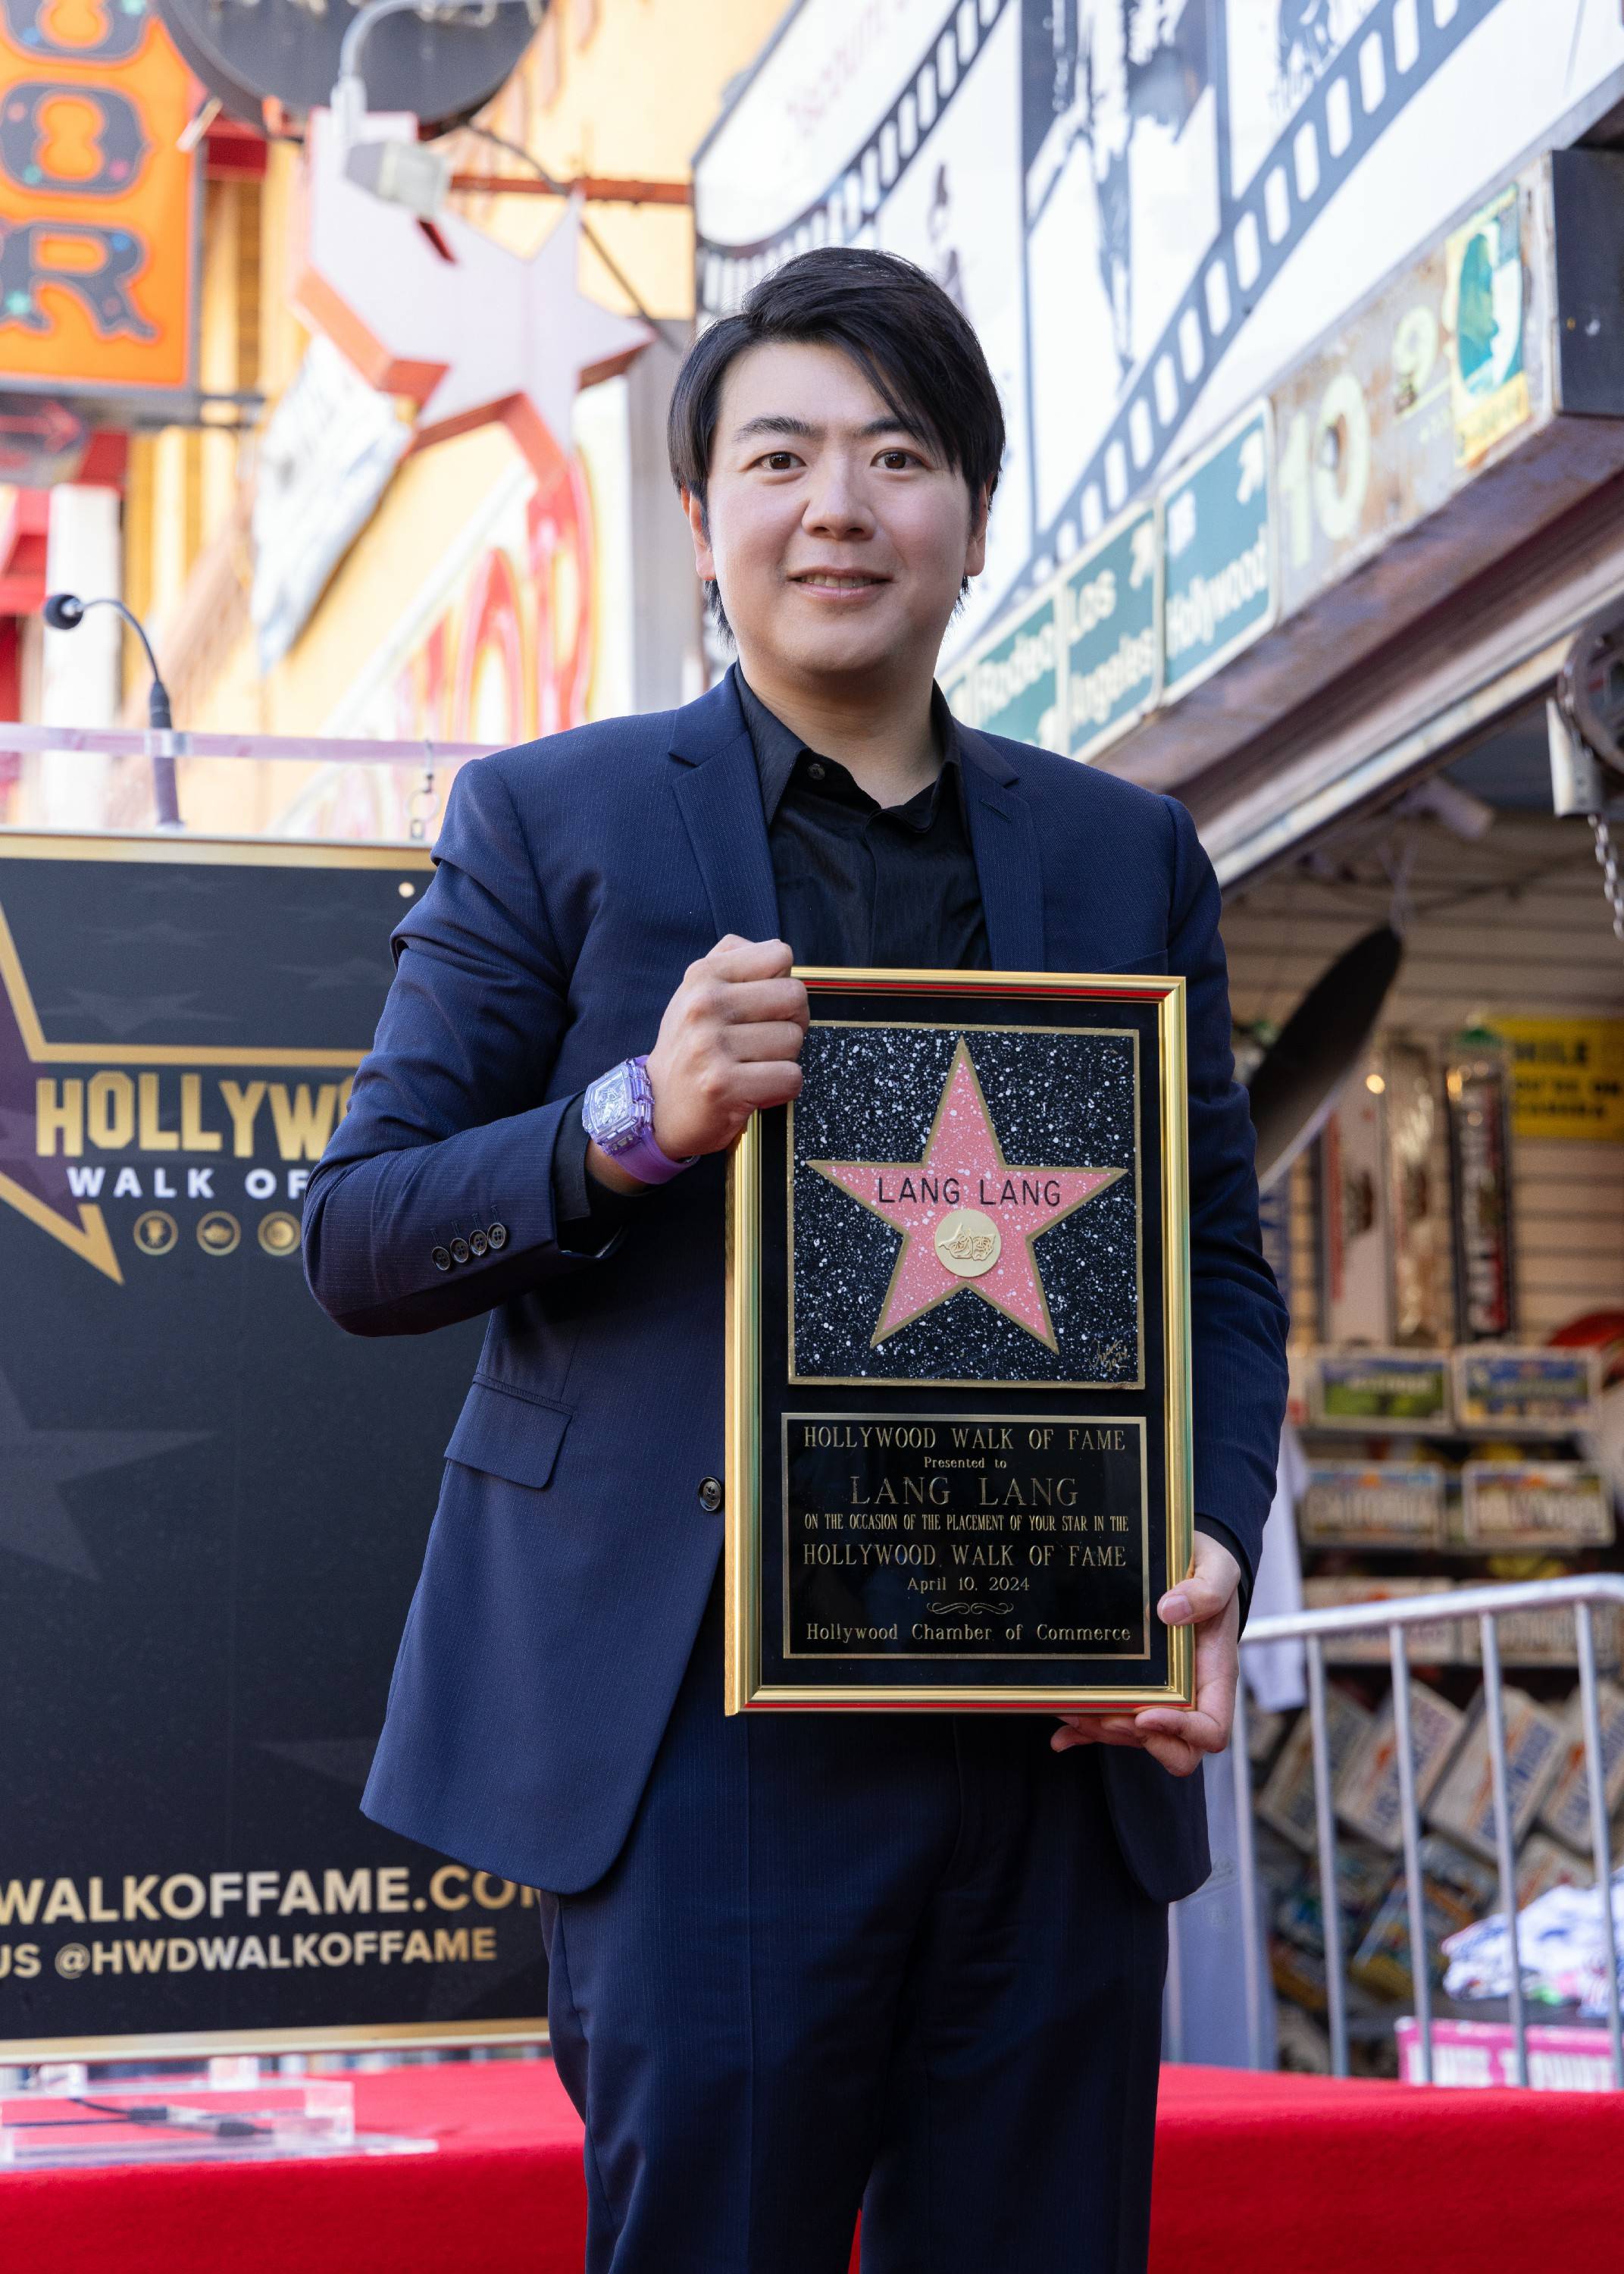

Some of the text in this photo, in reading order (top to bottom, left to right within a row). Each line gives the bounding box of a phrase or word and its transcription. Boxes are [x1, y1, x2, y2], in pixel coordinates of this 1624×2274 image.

[36, 1070, 353, 1161] HOLLYW
[67, 1167, 309, 1199] WALK OF
[879, 1177, 1060, 1207] LANG LANG
[804, 1427, 1125, 1450] HOLLYWOOD WALK OF FAME
[924, 1457, 1006, 1468] Presented to
[850, 1477, 1078, 1506] LANG LANG
[805, 1514, 1128, 1532] ON THE OCCASION OF THE PLACEMENT OF YOUR STAR IN THE
[803, 1543, 1126, 1567] HOLLYWOOD WALK OF FAME
[907, 1577, 947, 1594] April
[989, 1577, 1030, 1591] 2024
[806, 1623, 1131, 1643] Hollywood Chamber of Commerce
[55, 1927, 497, 1980] @HWDWALKOFFAME
